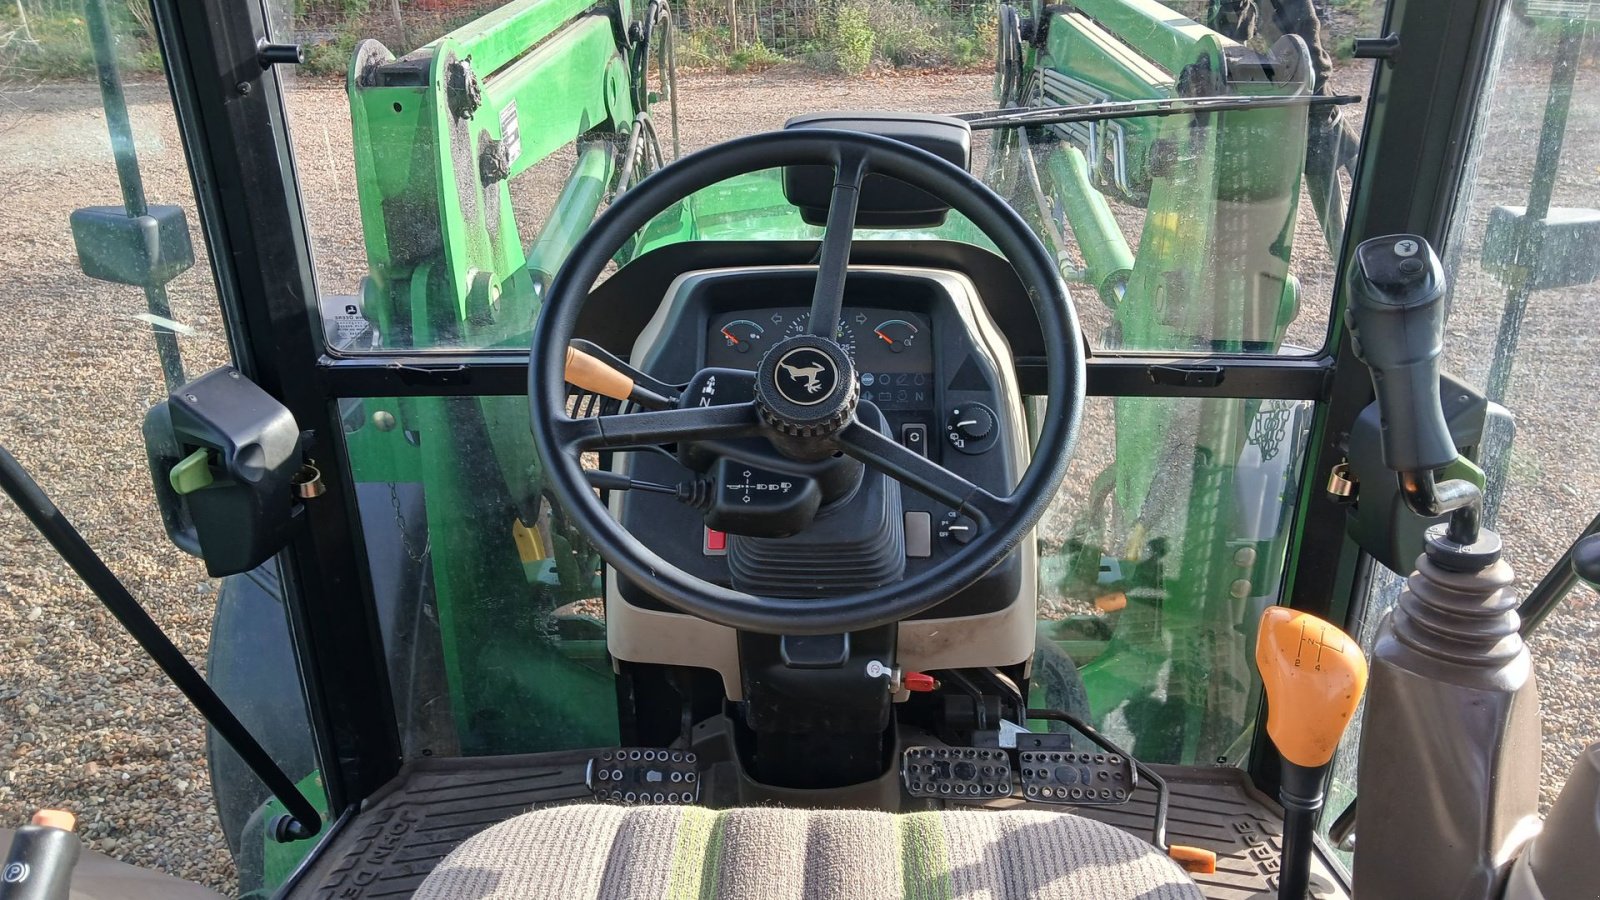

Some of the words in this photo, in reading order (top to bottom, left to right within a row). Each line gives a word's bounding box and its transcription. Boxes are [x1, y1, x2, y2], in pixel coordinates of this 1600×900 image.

[841, 343, 850, 351] 25
[915, 392, 924, 401] N
[699, 396, 711, 408] N
[1307, 637, 1315, 645] N
[1294, 658, 1301, 667] 2
[366, 810, 418, 866] JOHN
